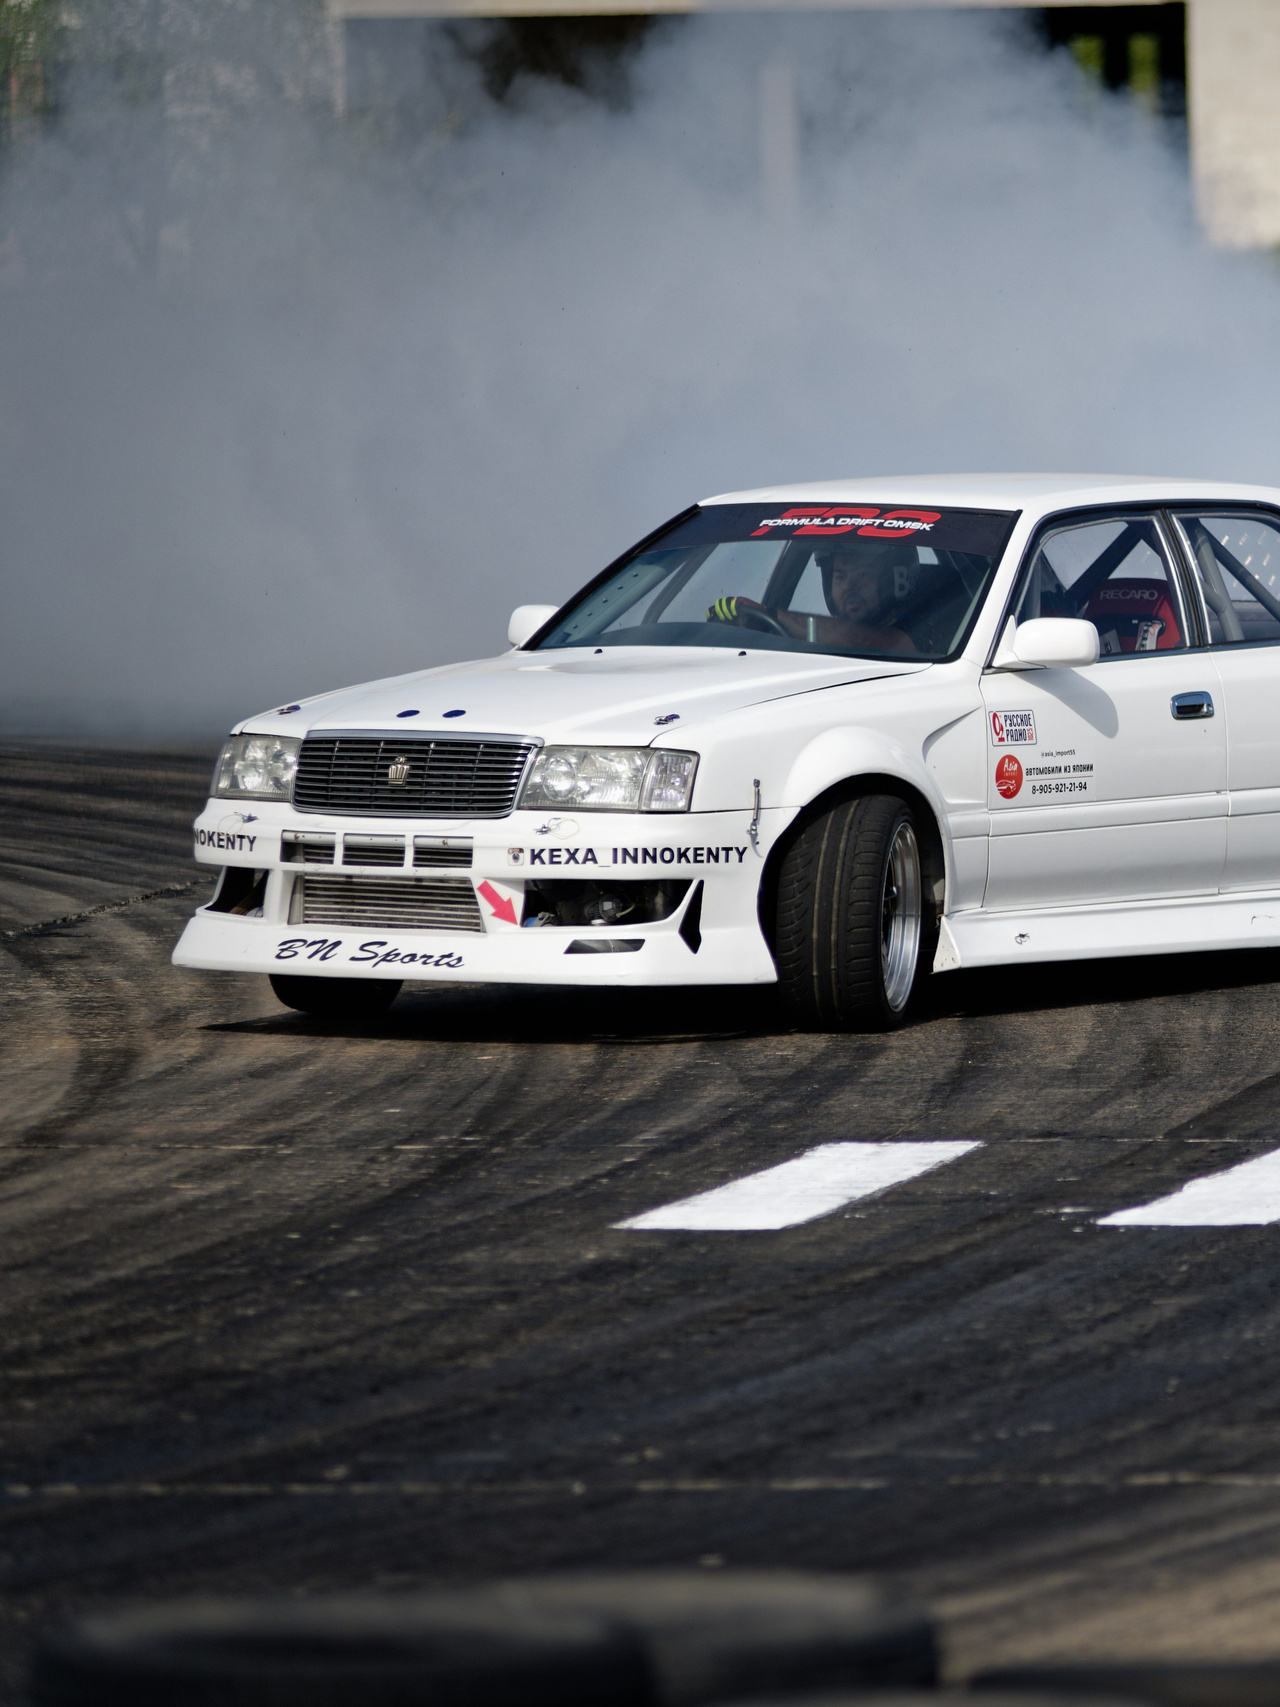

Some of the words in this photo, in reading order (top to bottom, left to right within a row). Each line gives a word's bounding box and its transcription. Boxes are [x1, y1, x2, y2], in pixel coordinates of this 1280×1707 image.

[759, 517, 835, 527] FORMULA
[836, 518, 884, 528] DRIFT
[883, 519, 935, 531] OMSK
[1100, 589, 1158, 600] RECARO
[1004, 713, 1032, 727] РУССКОЕ
[1006, 728, 1027, 742] РАДИО
[1003, 758, 1018, 772] Asia
[1031, 781, 1087, 795] 8-905-921-21-94
[529, 846, 748, 868] KEXA_INNOKENTY
[274, 938, 343, 962] BN
[348, 940, 466, 968] Sports
